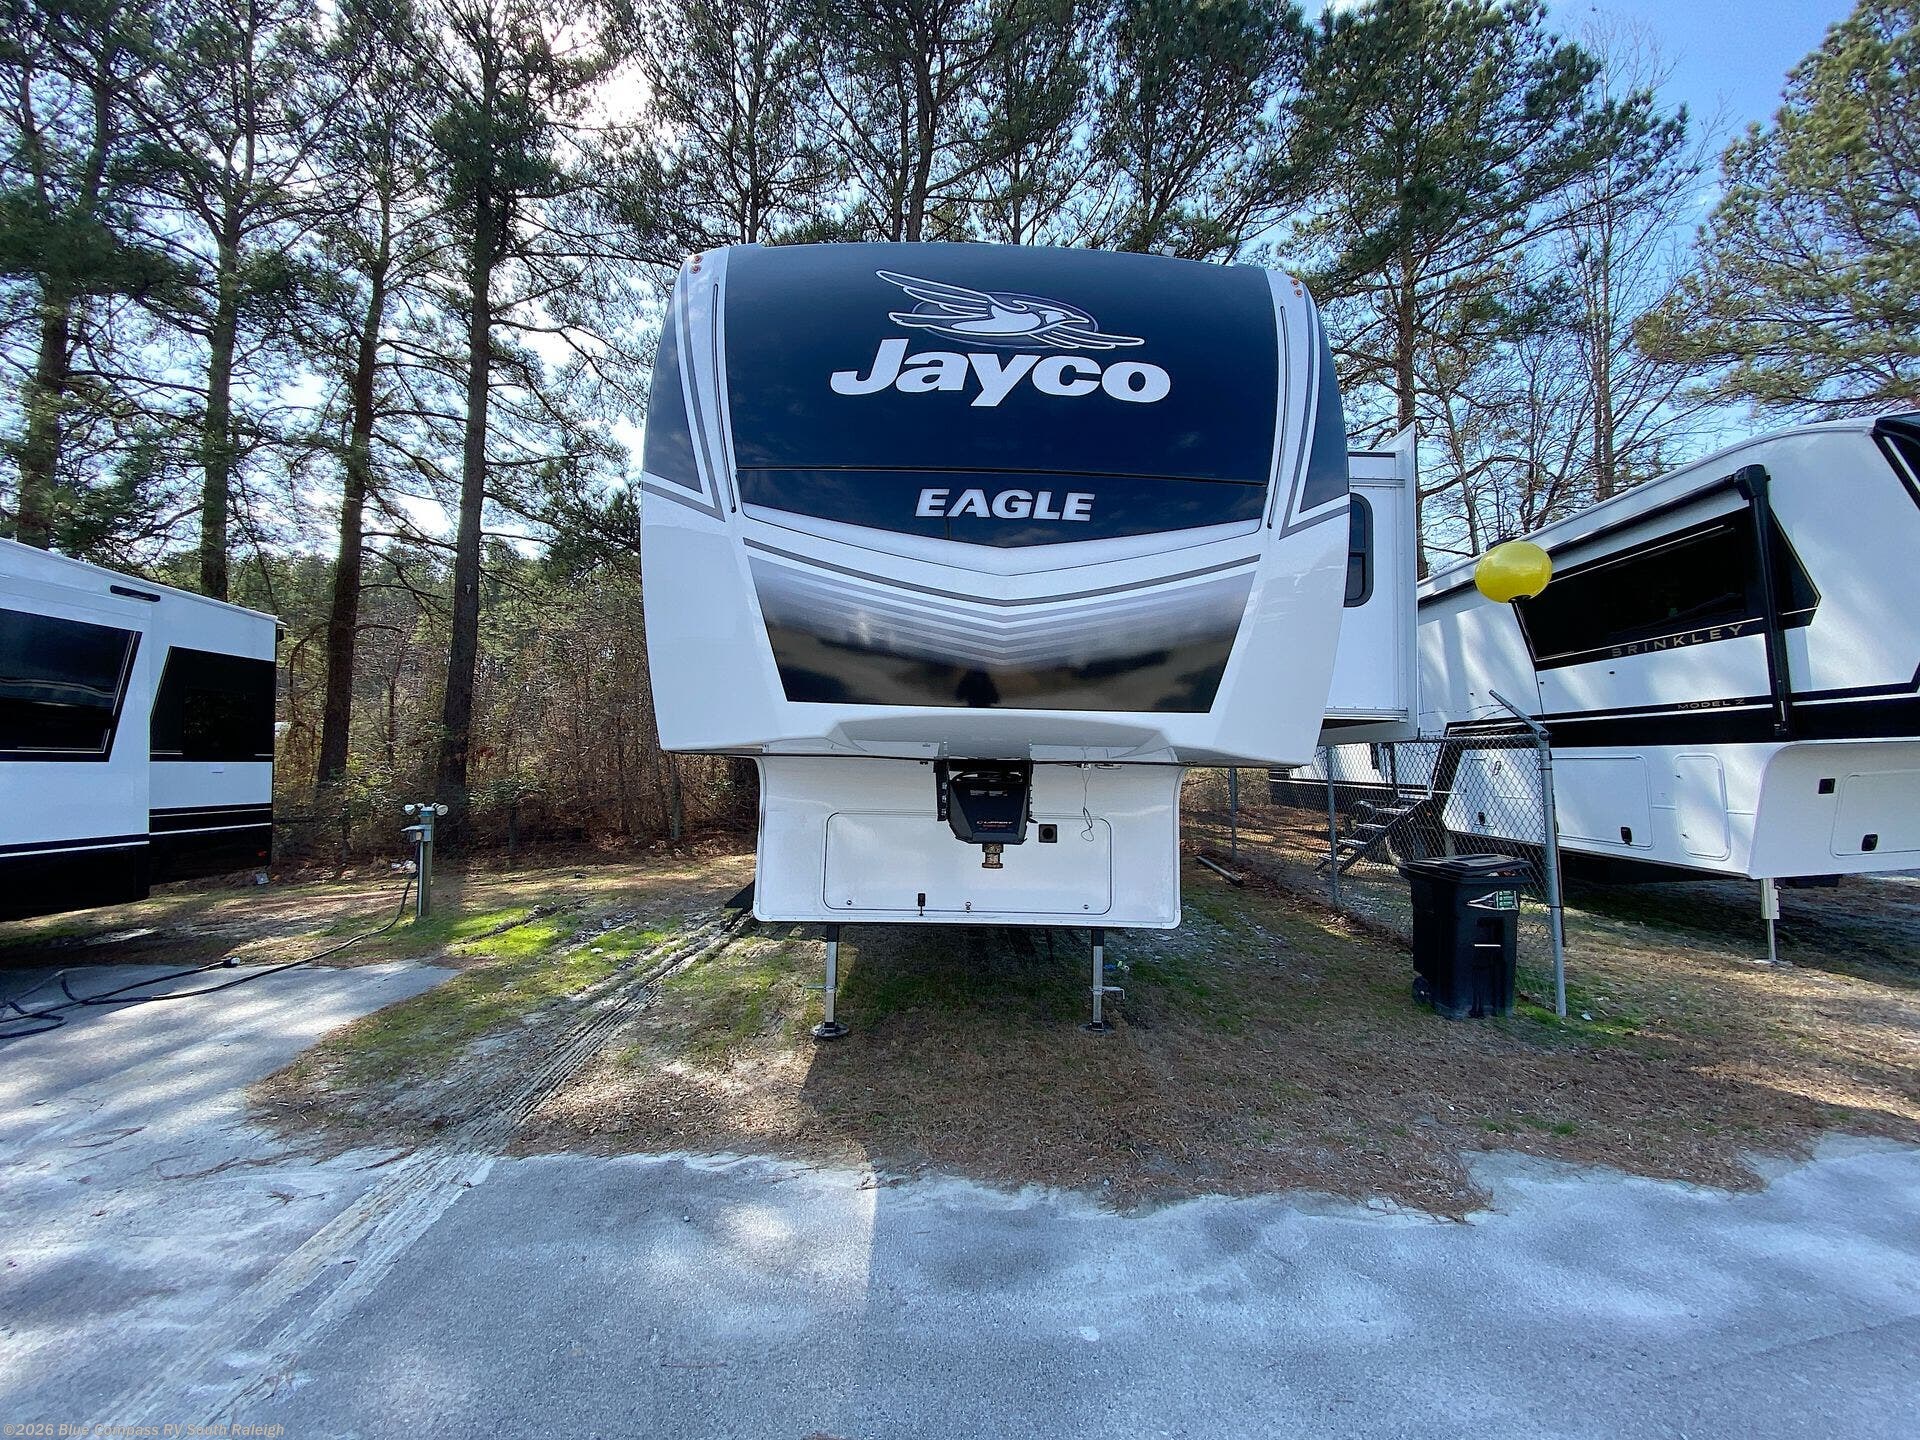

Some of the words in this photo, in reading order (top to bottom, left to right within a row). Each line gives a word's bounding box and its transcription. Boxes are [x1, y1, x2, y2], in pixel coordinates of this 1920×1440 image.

[829, 338, 1171, 407] Jayco
[915, 488, 1095, 522] EAGLE
[1612, 625, 1743, 657] BRINKLEY
[1678, 700, 1731, 709] MODEL
